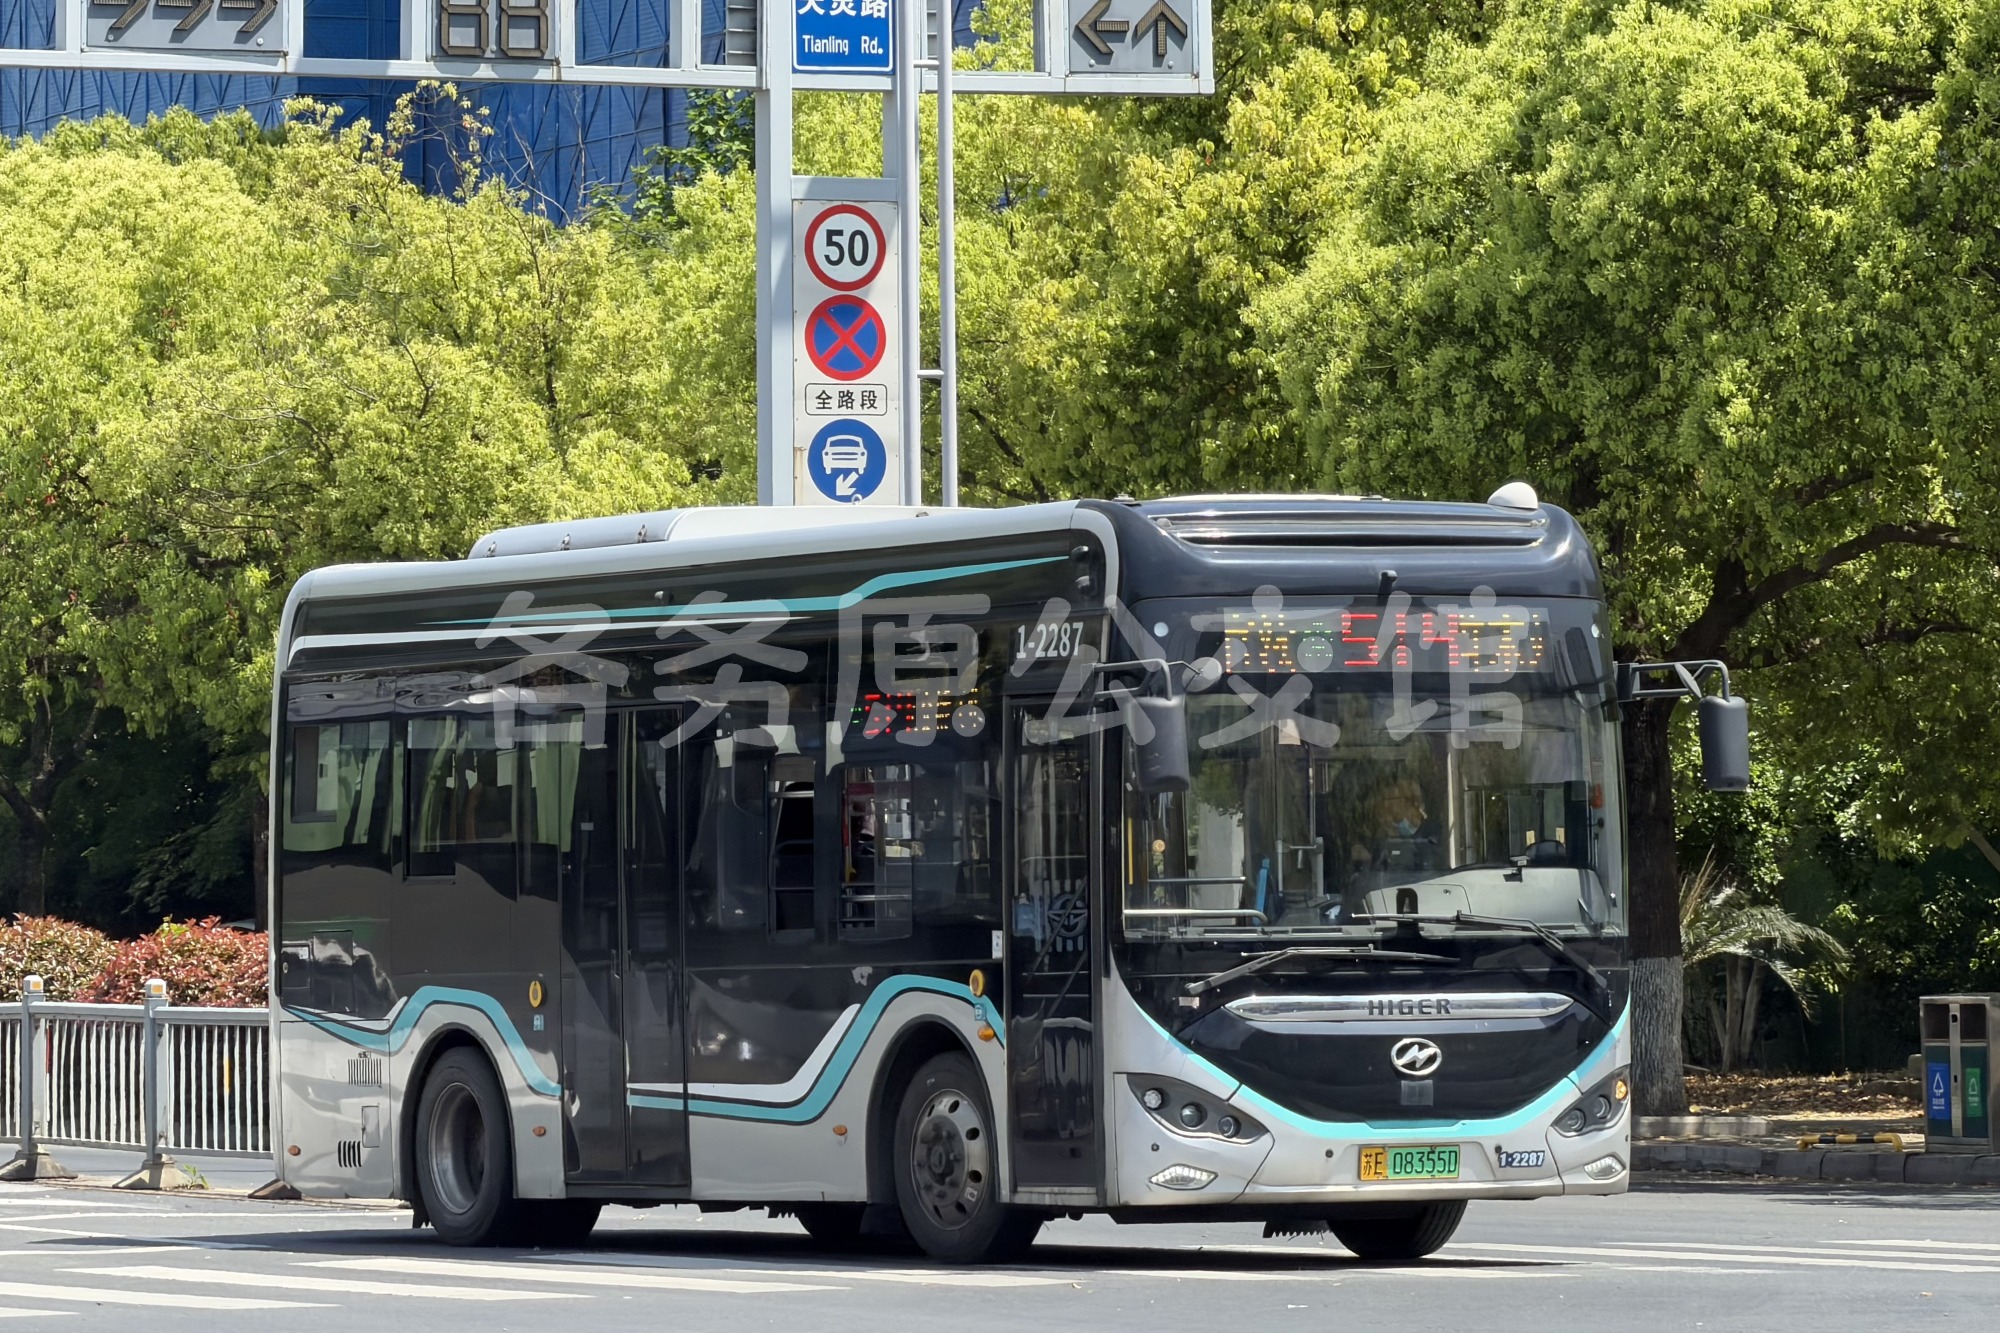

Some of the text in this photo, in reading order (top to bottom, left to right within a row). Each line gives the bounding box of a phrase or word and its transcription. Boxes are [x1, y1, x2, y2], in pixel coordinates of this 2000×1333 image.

[802, 35, 884, 55] Tianling Rd.
[824, 229, 869, 266] 50
[815, 389, 878, 411] 全路段
[1016, 622, 1084, 659] 1-2287
[1368, 999, 1451, 1016] HIGER
